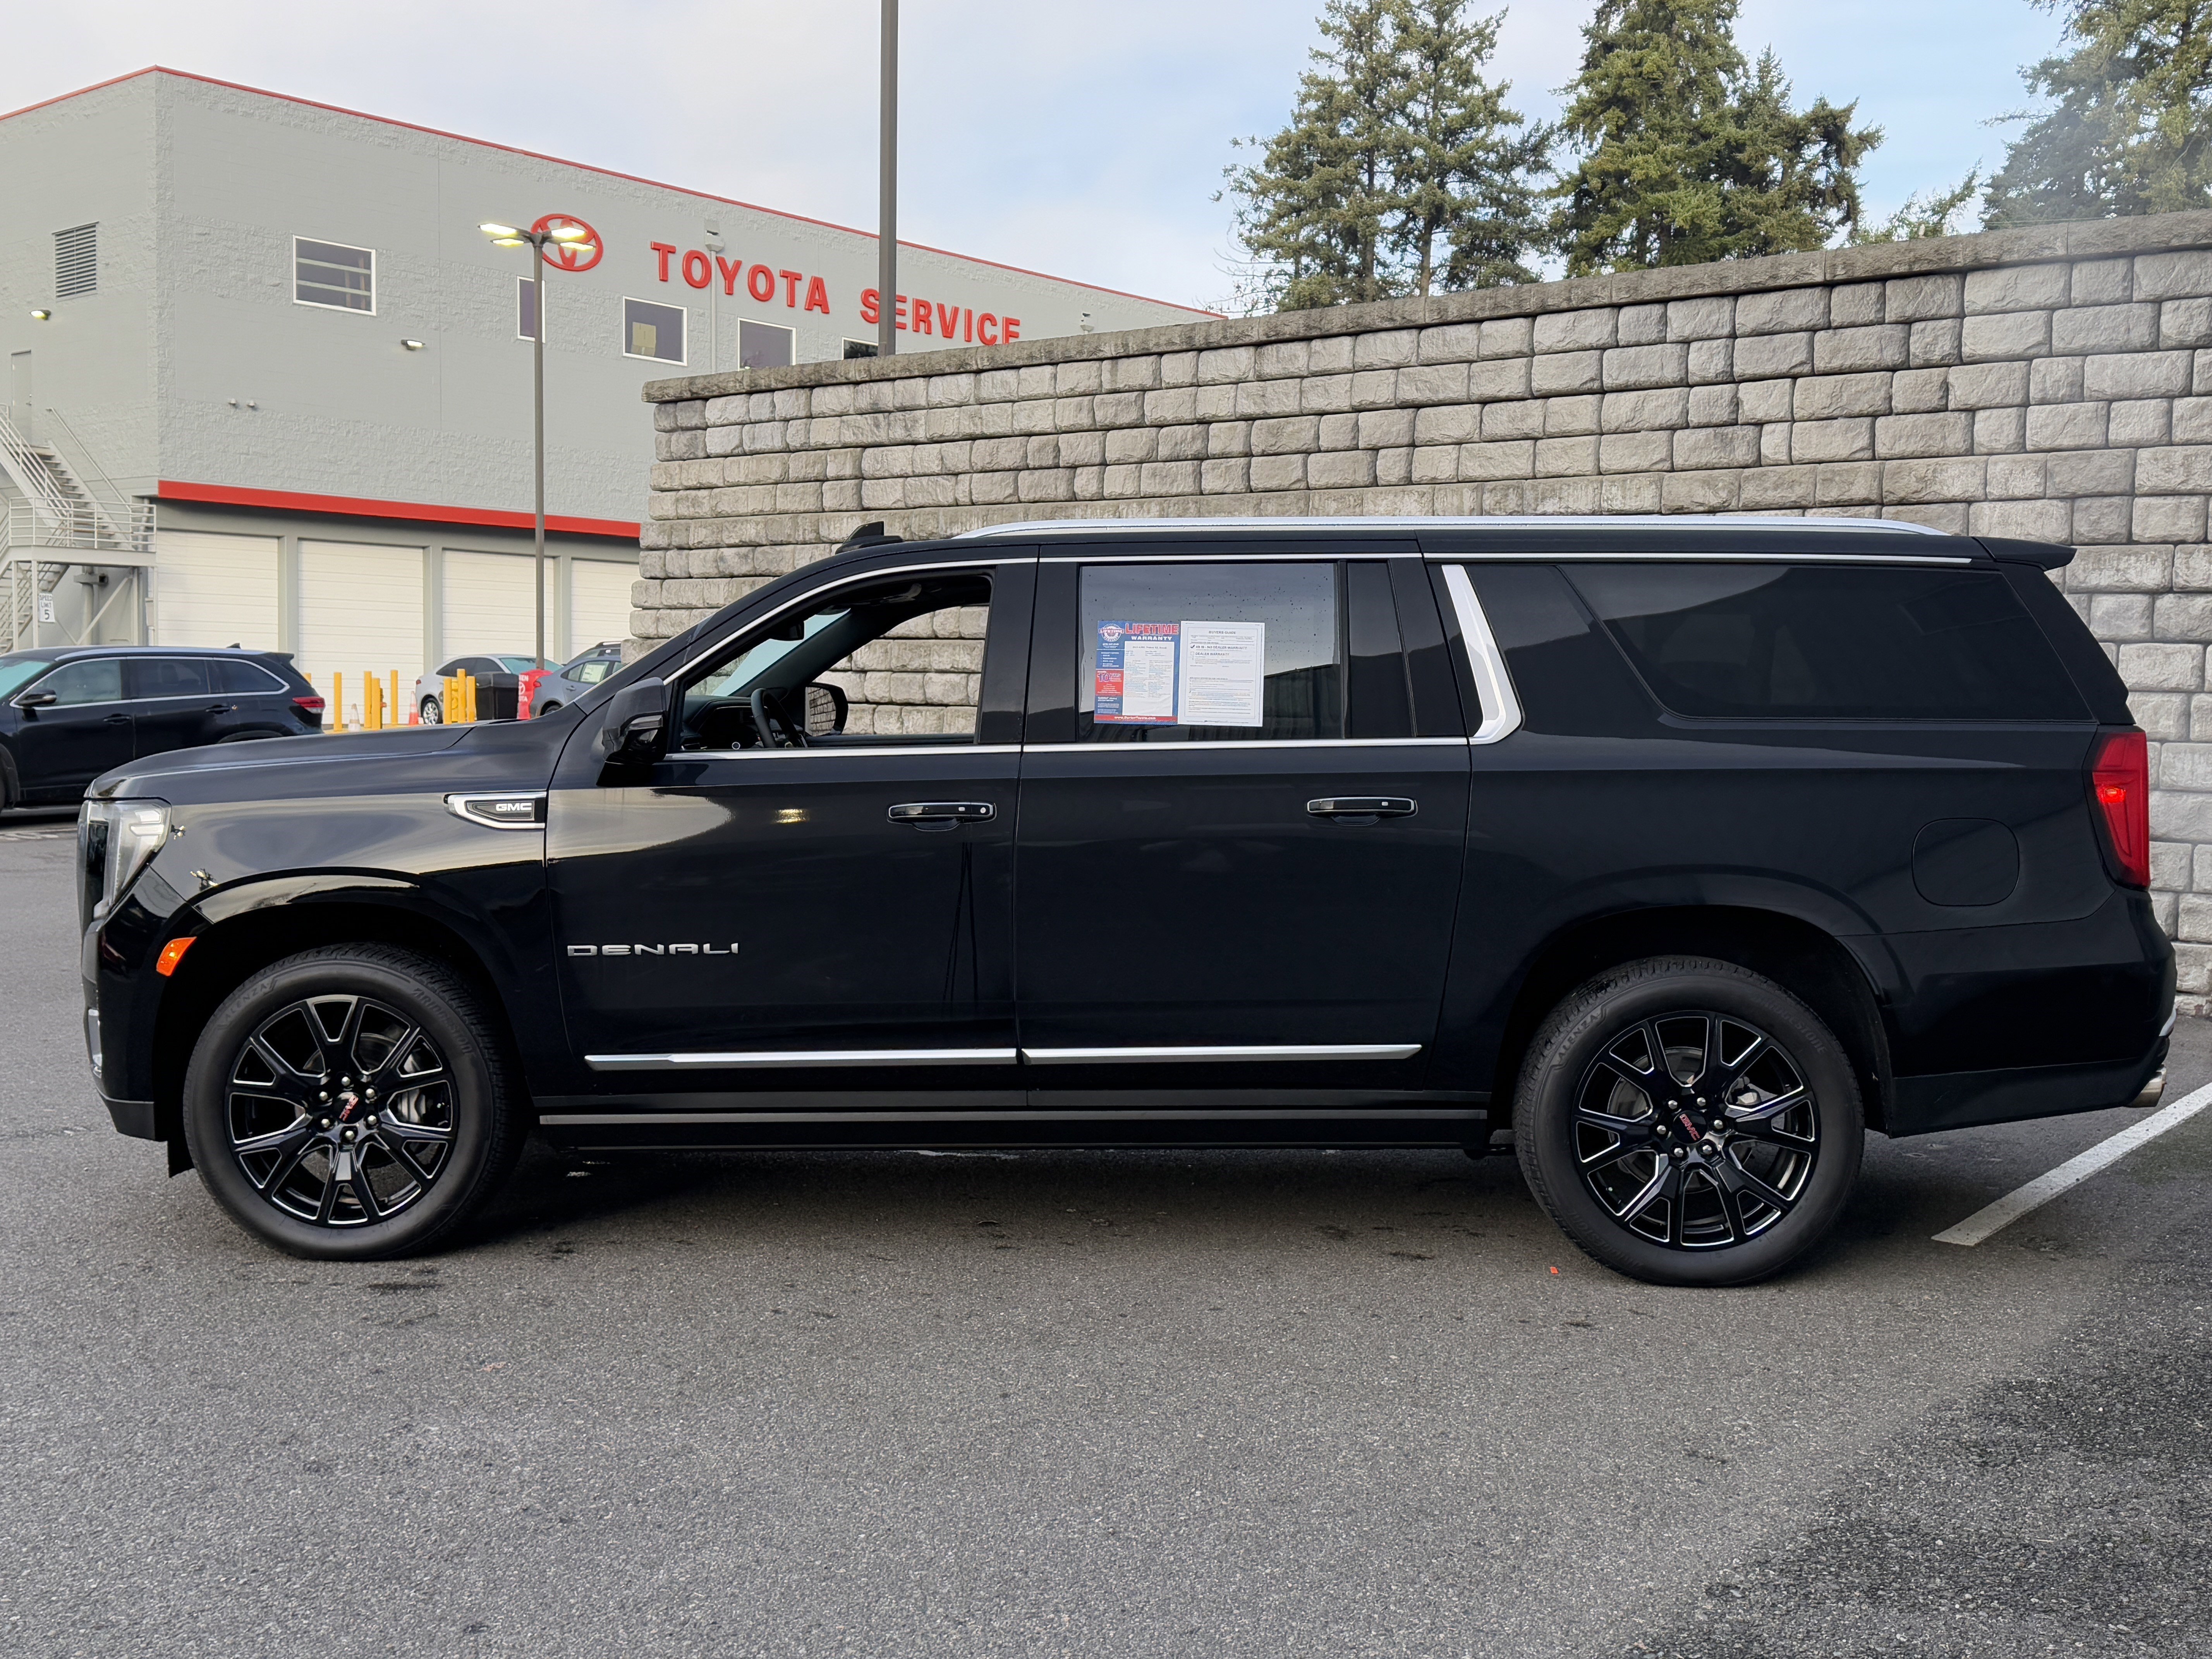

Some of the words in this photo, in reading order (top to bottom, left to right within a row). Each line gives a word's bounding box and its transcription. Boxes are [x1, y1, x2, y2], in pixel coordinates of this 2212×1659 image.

[651, 241, 830, 313] TOYOTA
[860, 288, 1020, 345] SERVICE
[45, 609, 50, 620] 5
[1125, 623, 1179, 634] LIFETIME
[1097, 673, 1110, 682] 10
[496, 802, 532, 811] GMC
[567, 943, 738, 957] DENALI
[225, 983, 267, 1022] ALENZA
[1558, 1015, 1598, 1062] ALENZA
[339, 1095, 359, 1121] GMC
[1680, 1114, 1700, 1141] GMC
